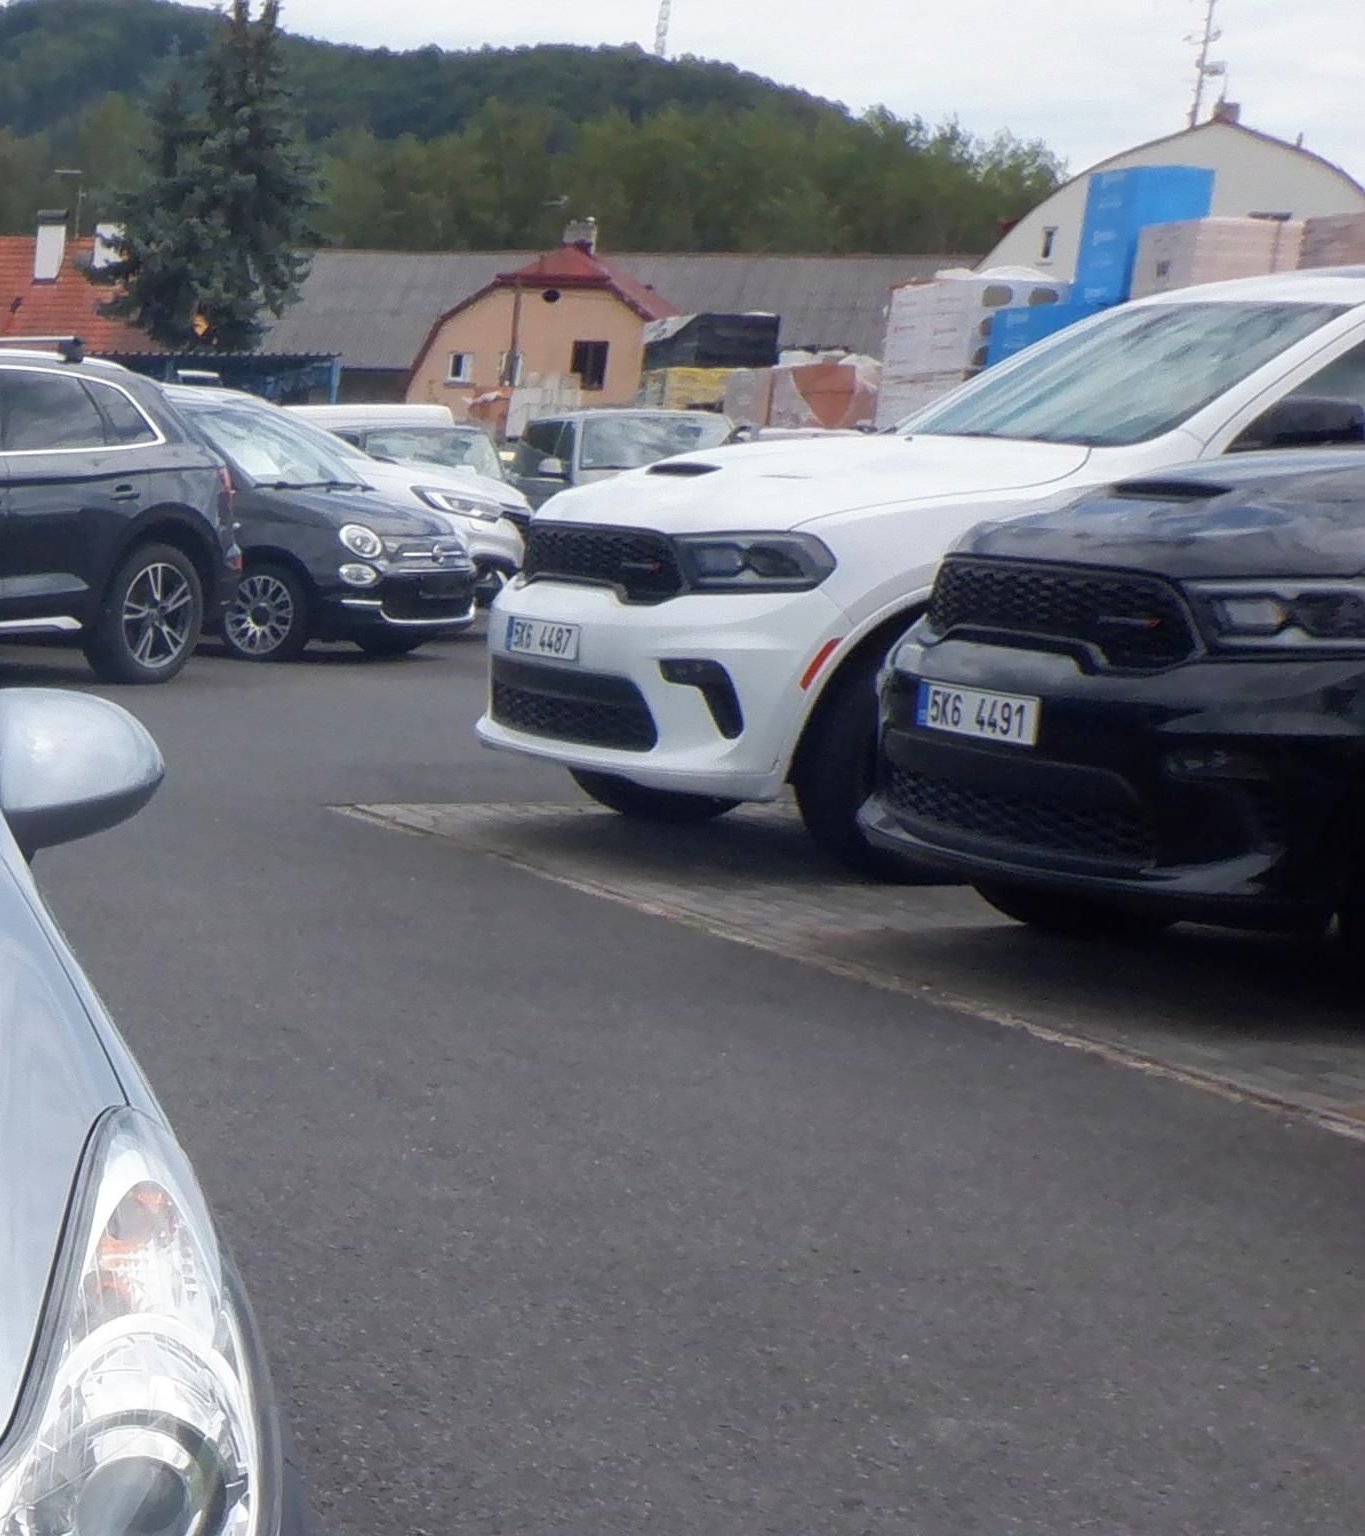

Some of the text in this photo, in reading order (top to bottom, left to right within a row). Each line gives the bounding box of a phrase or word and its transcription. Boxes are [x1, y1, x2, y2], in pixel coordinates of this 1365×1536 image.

[539, 625, 572, 654] 4487
[930, 690, 1025, 738] 5K6 4491
